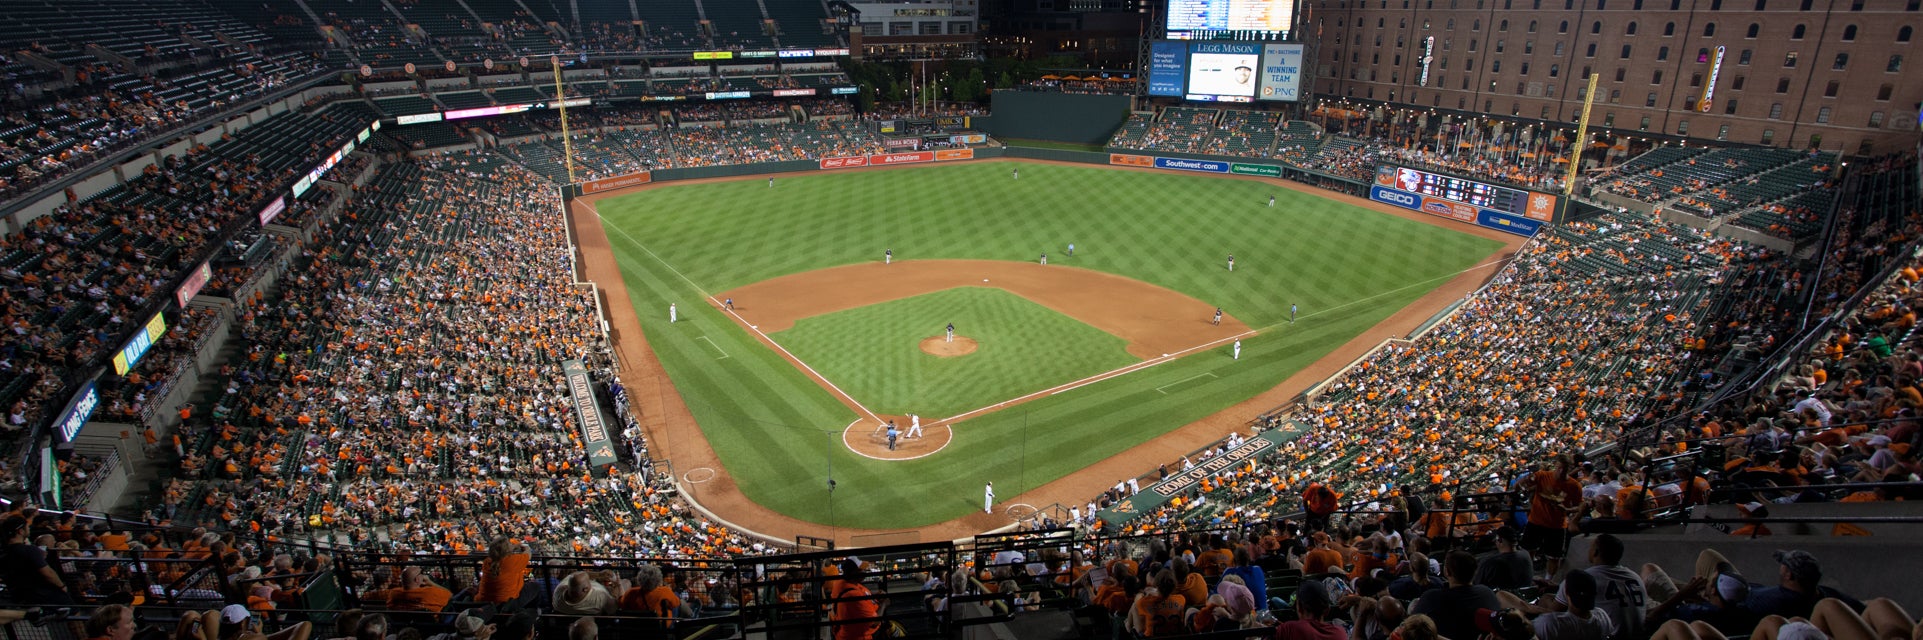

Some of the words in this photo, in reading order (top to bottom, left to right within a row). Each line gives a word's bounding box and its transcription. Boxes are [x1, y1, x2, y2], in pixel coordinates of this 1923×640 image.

[1197, 43, 1221, 53] LEGG
[1222, 44, 1254, 53] MASON
[1267, 66, 1297, 74] WINNING
[1275, 88, 1295, 96] PNC
[1379, 190, 1414, 205] GEICO
[1426, 204, 1452, 214] HORIZON
[126, 341, 140, 364] OLD
[136, 330, 150, 354] BAY
[571, 374, 590, 398] WELCOME
[578, 397, 592, 406] TO
[62, 411, 82, 442] LONG
[77, 388, 98, 421] FENCE
[581, 405, 599, 427] ORIOLE
[587, 425, 604, 442] PARK
[1156, 476, 1192, 495] HOME
[1190, 467, 1209, 482] OF
[1205, 456, 1231, 473] THE
[1228, 439, 1270, 461] ORIOLES
[1605, 579, 1644, 607] 46
